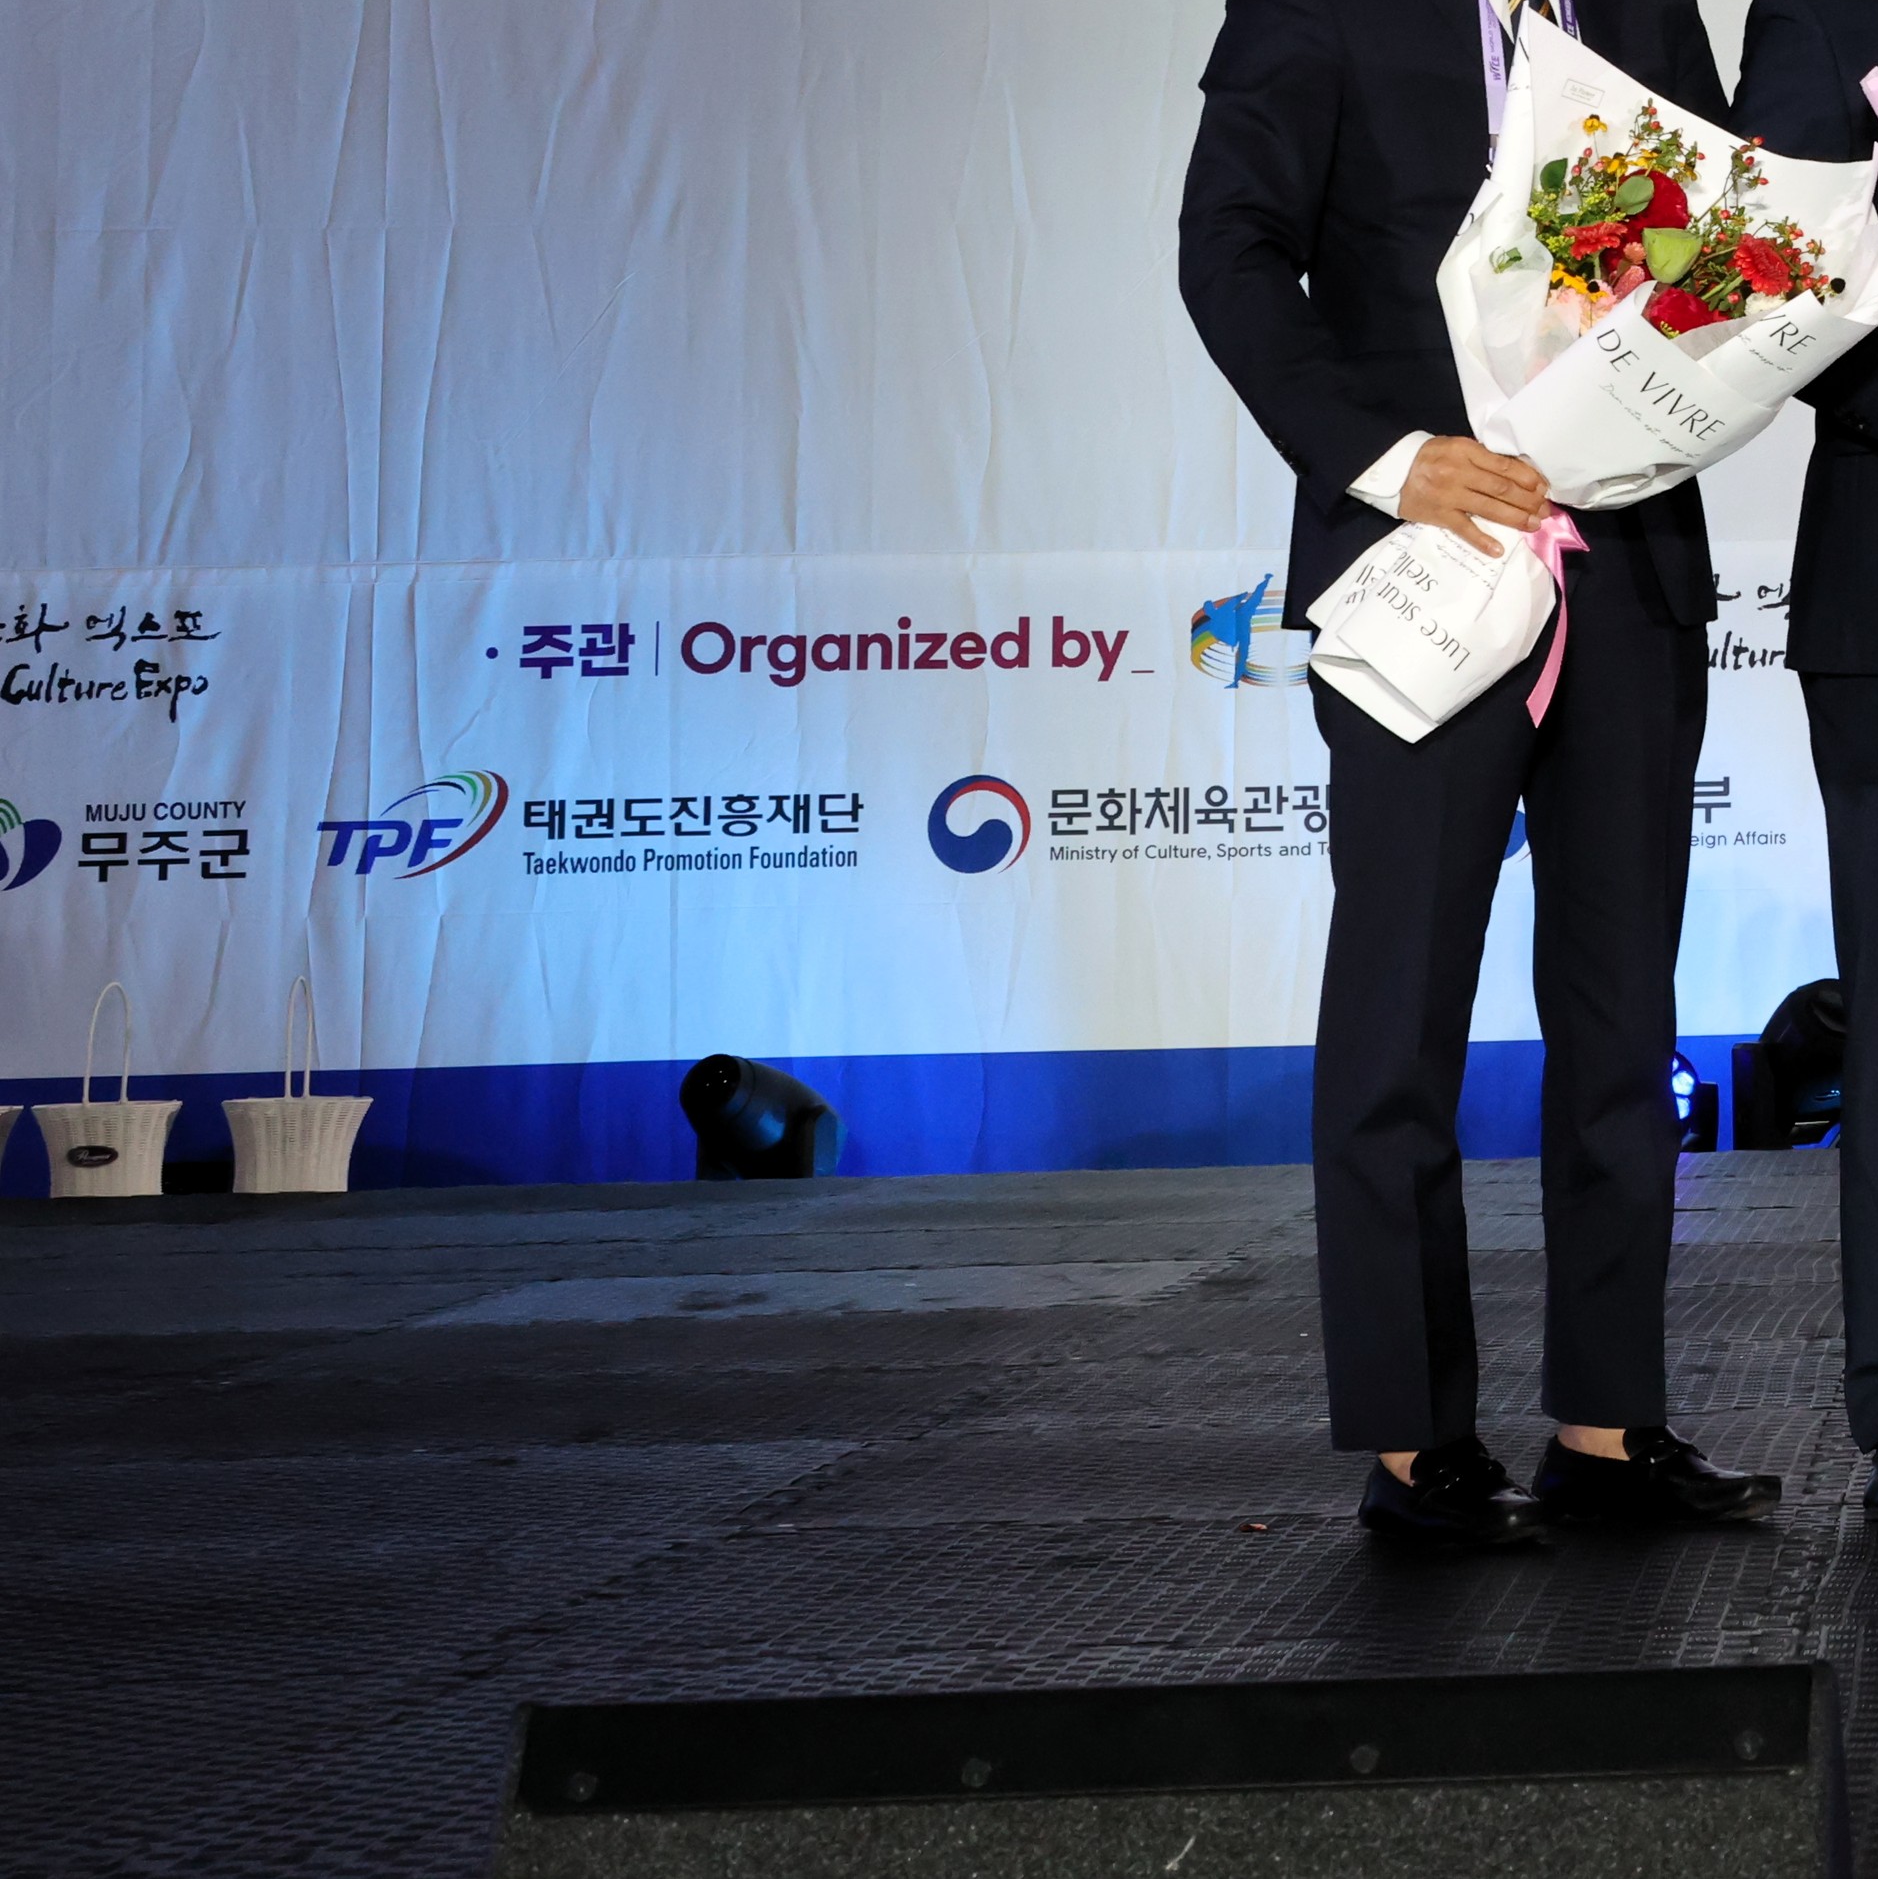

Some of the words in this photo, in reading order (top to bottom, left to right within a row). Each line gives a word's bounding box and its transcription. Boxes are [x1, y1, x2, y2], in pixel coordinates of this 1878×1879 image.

[1596, 328, 1640, 373] DE
[1640, 371, 1726, 442] VIVRE
[1376, 581, 1422, 622] sicut
[0, 603, 70, 653] 화
[84, 604, 222, 651] 엑스포
[519, 622, 636, 680] 주관
[680, 615, 1031, 688] Organized
[1419, 619, 1471, 672] Luce
[0, 661, 129, 706] Culture
[133, 659, 209, 723] Expo
[85, 802, 148, 823] MUJU
[152, 800, 246, 821] COUNTY
[522, 792, 864, 841] 태권도진흥재단
[77, 828, 251, 883] 무주군
[316, 817, 464, 876] TPF
[522, 848, 636, 876] Taekwondo
[643, 846, 743, 872] Promotion
[749, 844, 859, 870] Foundation
[1049, 844, 1118, 864] Ministry
[1122, 844, 1140, 860] of
[1144, 843, 1212, 862] Culture,
[1216, 842, 1273, 862] Sports
[1278, 841, 1312, 858] and
[1733, 830, 1787, 846] Affairs
